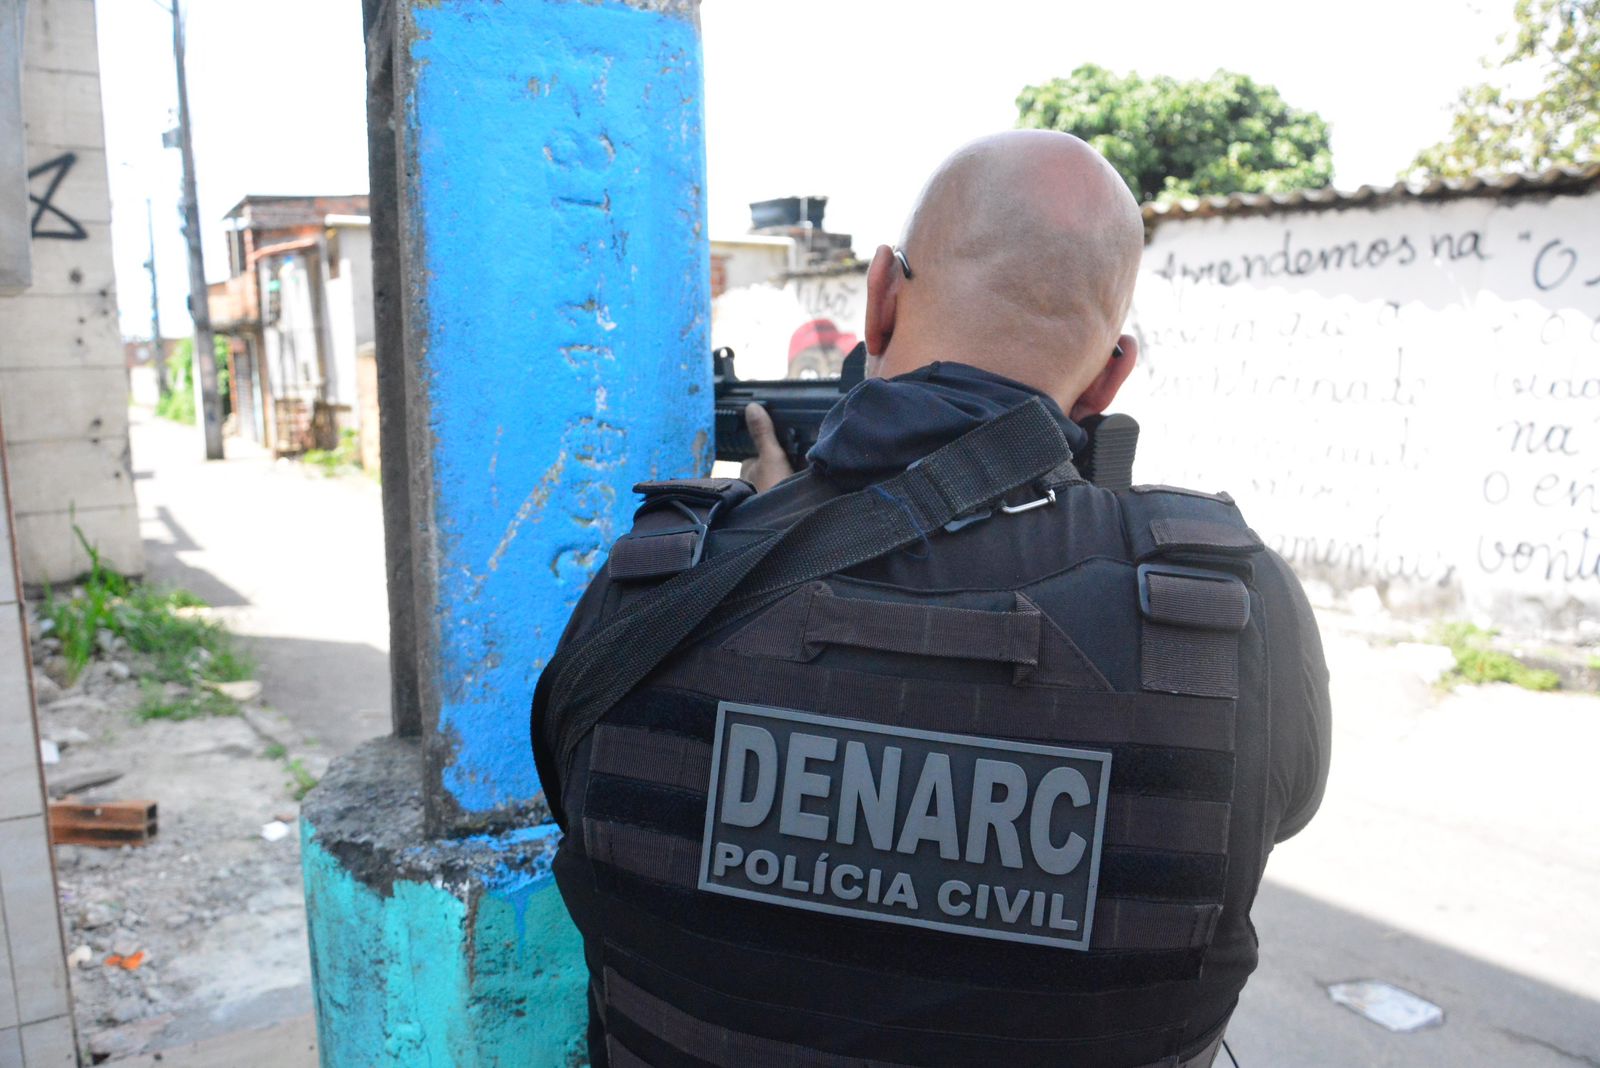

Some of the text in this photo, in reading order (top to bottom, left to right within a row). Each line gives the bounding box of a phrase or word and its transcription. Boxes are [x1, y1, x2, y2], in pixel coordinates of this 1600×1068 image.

[1431, 229, 1494, 262] na
[1497, 419, 1580, 456] na
[720, 723, 1091, 876] DENARC
[713, 841, 1079, 931] POLÍCIA CIVIL
